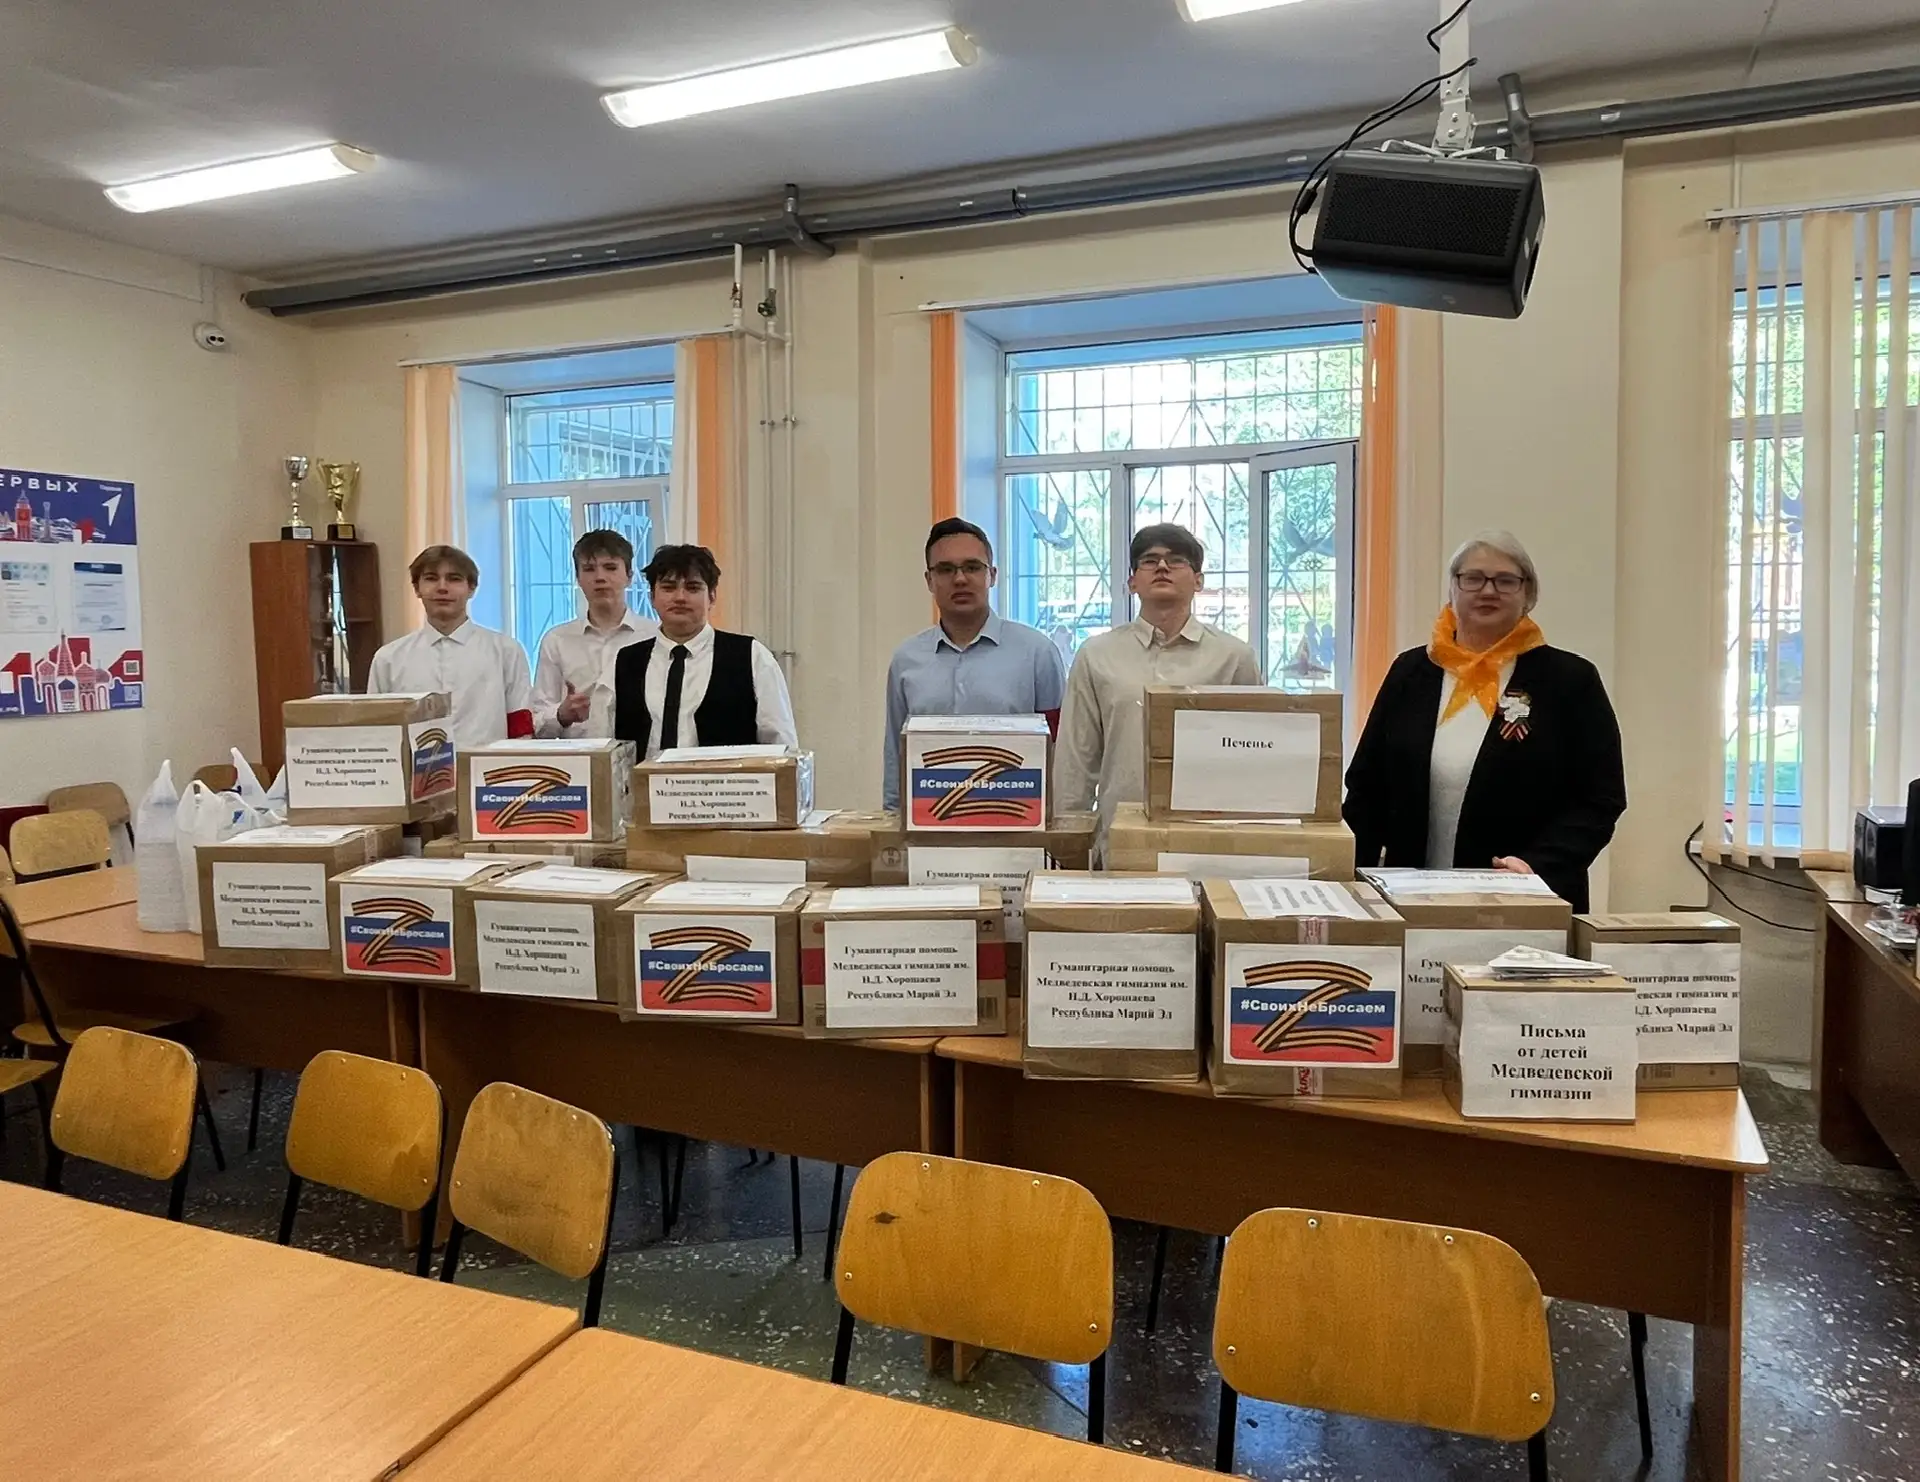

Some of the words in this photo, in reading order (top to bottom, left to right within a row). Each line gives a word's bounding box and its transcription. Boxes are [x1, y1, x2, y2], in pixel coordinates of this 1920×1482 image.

[1222, 736, 1274, 751] Печенье
[665, 778, 724, 786] Гуманитарная
[920, 778, 1034, 790] #СвоихНеБросаем
[482, 794, 581, 803] #СвоихНеБросаем
[926, 870, 990, 879] Гуманитарная
[350, 925, 444, 938] #СвоихНеБросаем
[845, 946, 916, 957] Гуманитарная
[648, 960, 764, 972] #СвоихНеБросаем
[1050, 962, 1128, 974] Гуманитарная
[1132, 965, 1175, 973] помощь
[1036, 978, 1112, 987] Медведевская
[1116, 980, 1167, 988] гимназия
[1692, 975, 1736, 983] помощь
[847, 991, 903, 1000] Республика
[907, 991, 940, 1000] Марий
[1068, 992, 1092, 1001] Н.Д.
[1095, 992, 1155, 1003] Хорошаева
[1676, 991, 1728, 999] гимназия
[1241, 1000, 1386, 1014] #СвоихНеБросаем
[1656, 1006, 1716, 1017] Хорошаева
[1051, 1007, 1114, 1020] Республика
[1118, 1009, 1154, 1021] Марий
[1159, 1009, 1172, 1020] Эл
[1520, 1024, 1585, 1038] Письма
[1677, 1023, 1715, 1034] Марий
[1718, 1024, 1732, 1032] Эл
[1518, 1048, 1536, 1058] от
[1540, 1046, 1587, 1059] детей
[1491, 1064, 1612, 1080] Медведевской
[1510, 1088, 1591, 1100] гимназии
